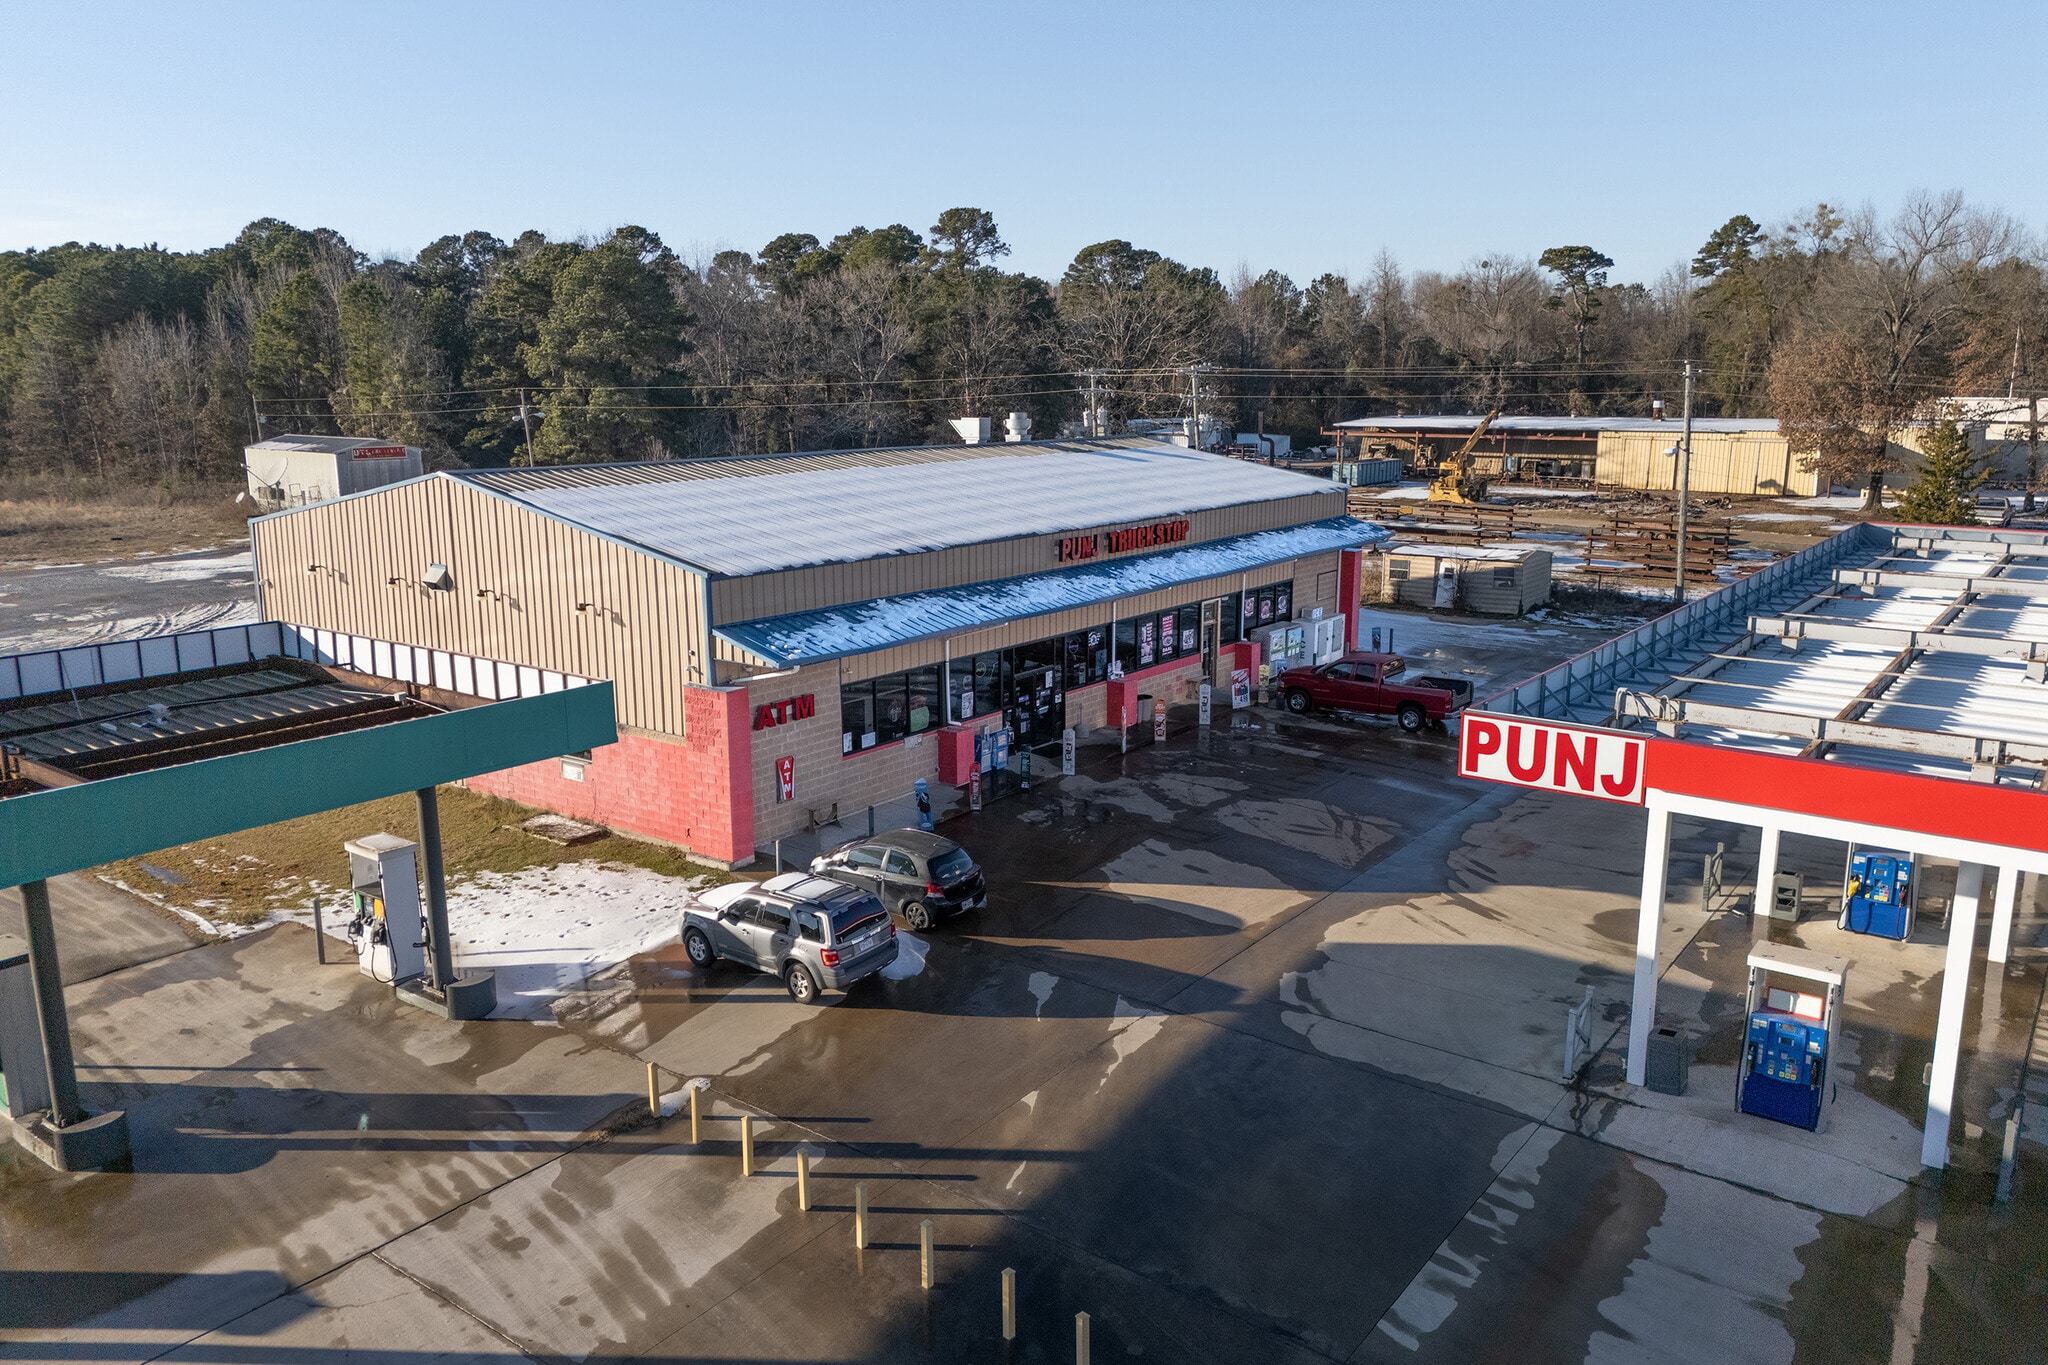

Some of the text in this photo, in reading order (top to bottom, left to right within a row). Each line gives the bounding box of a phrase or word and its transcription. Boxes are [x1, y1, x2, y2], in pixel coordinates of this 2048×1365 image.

[1060, 534, 1100, 562] PUNJ
[755, 694, 815, 730] ATM
[1465, 719, 1640, 797] PUNJ
[783, 760, 792, 793] ATM
